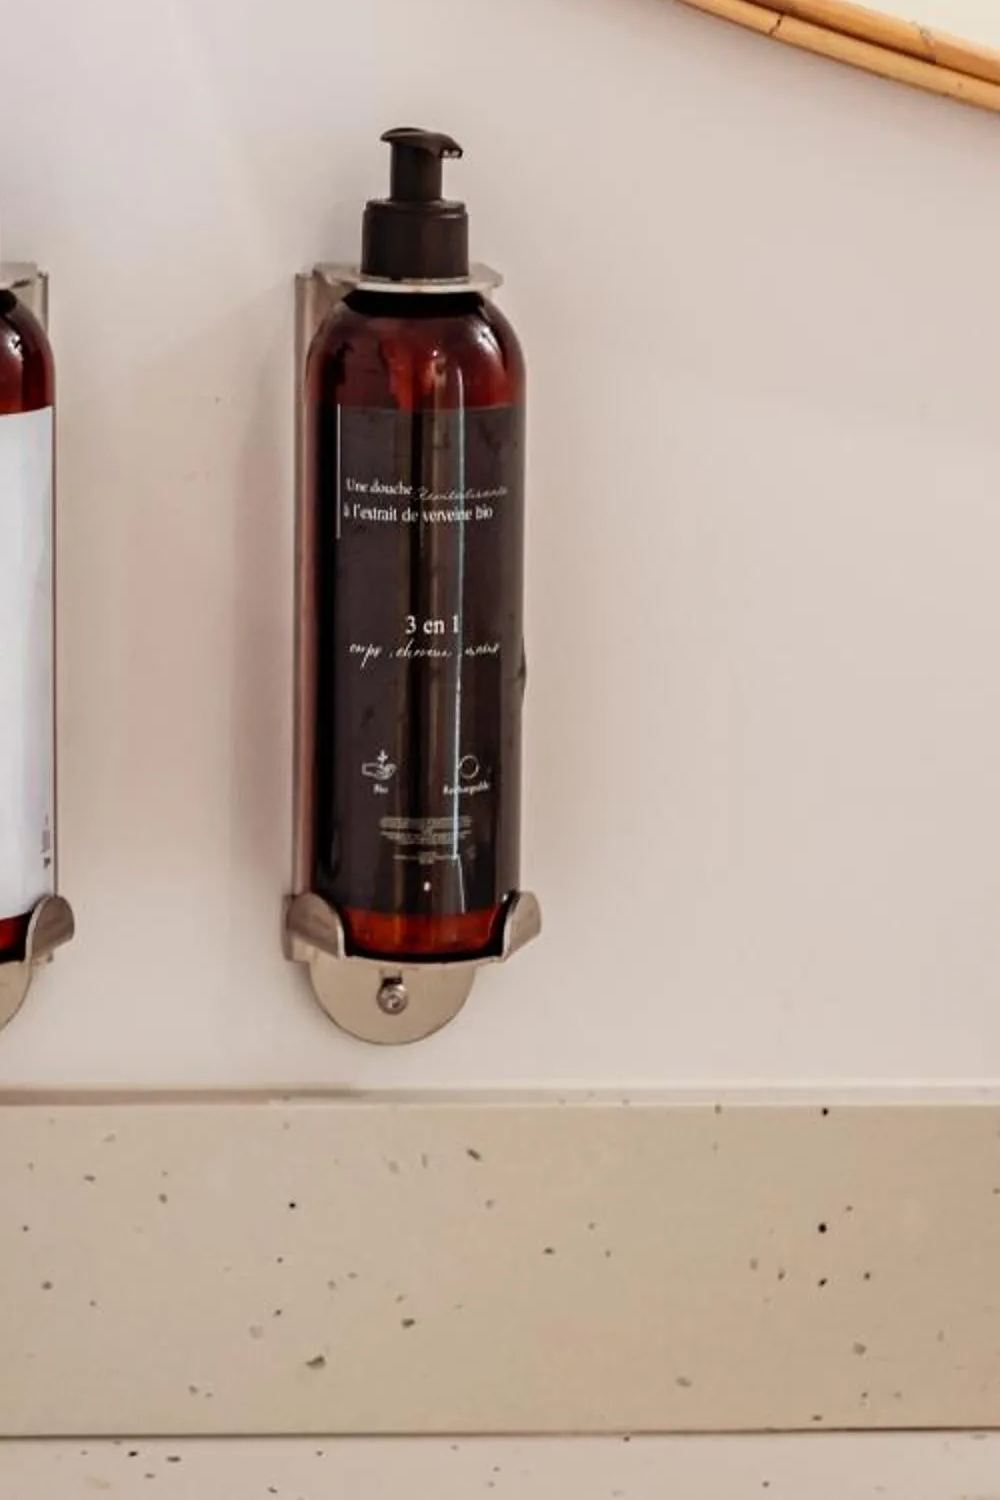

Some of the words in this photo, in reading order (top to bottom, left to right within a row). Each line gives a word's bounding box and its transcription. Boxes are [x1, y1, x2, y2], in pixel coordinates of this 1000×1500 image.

[345, 478, 369, 493] Une
[370, 478, 413, 495] douche
[353, 503, 397, 521] l'extrait
[401, 507, 419, 522] de
[422, 509, 472, 522] verveine
[475, 503, 493, 520] bio
[405, 615, 416, 634] 3
[423, 620, 445, 635] en
[452, 615, 459, 633] 1
